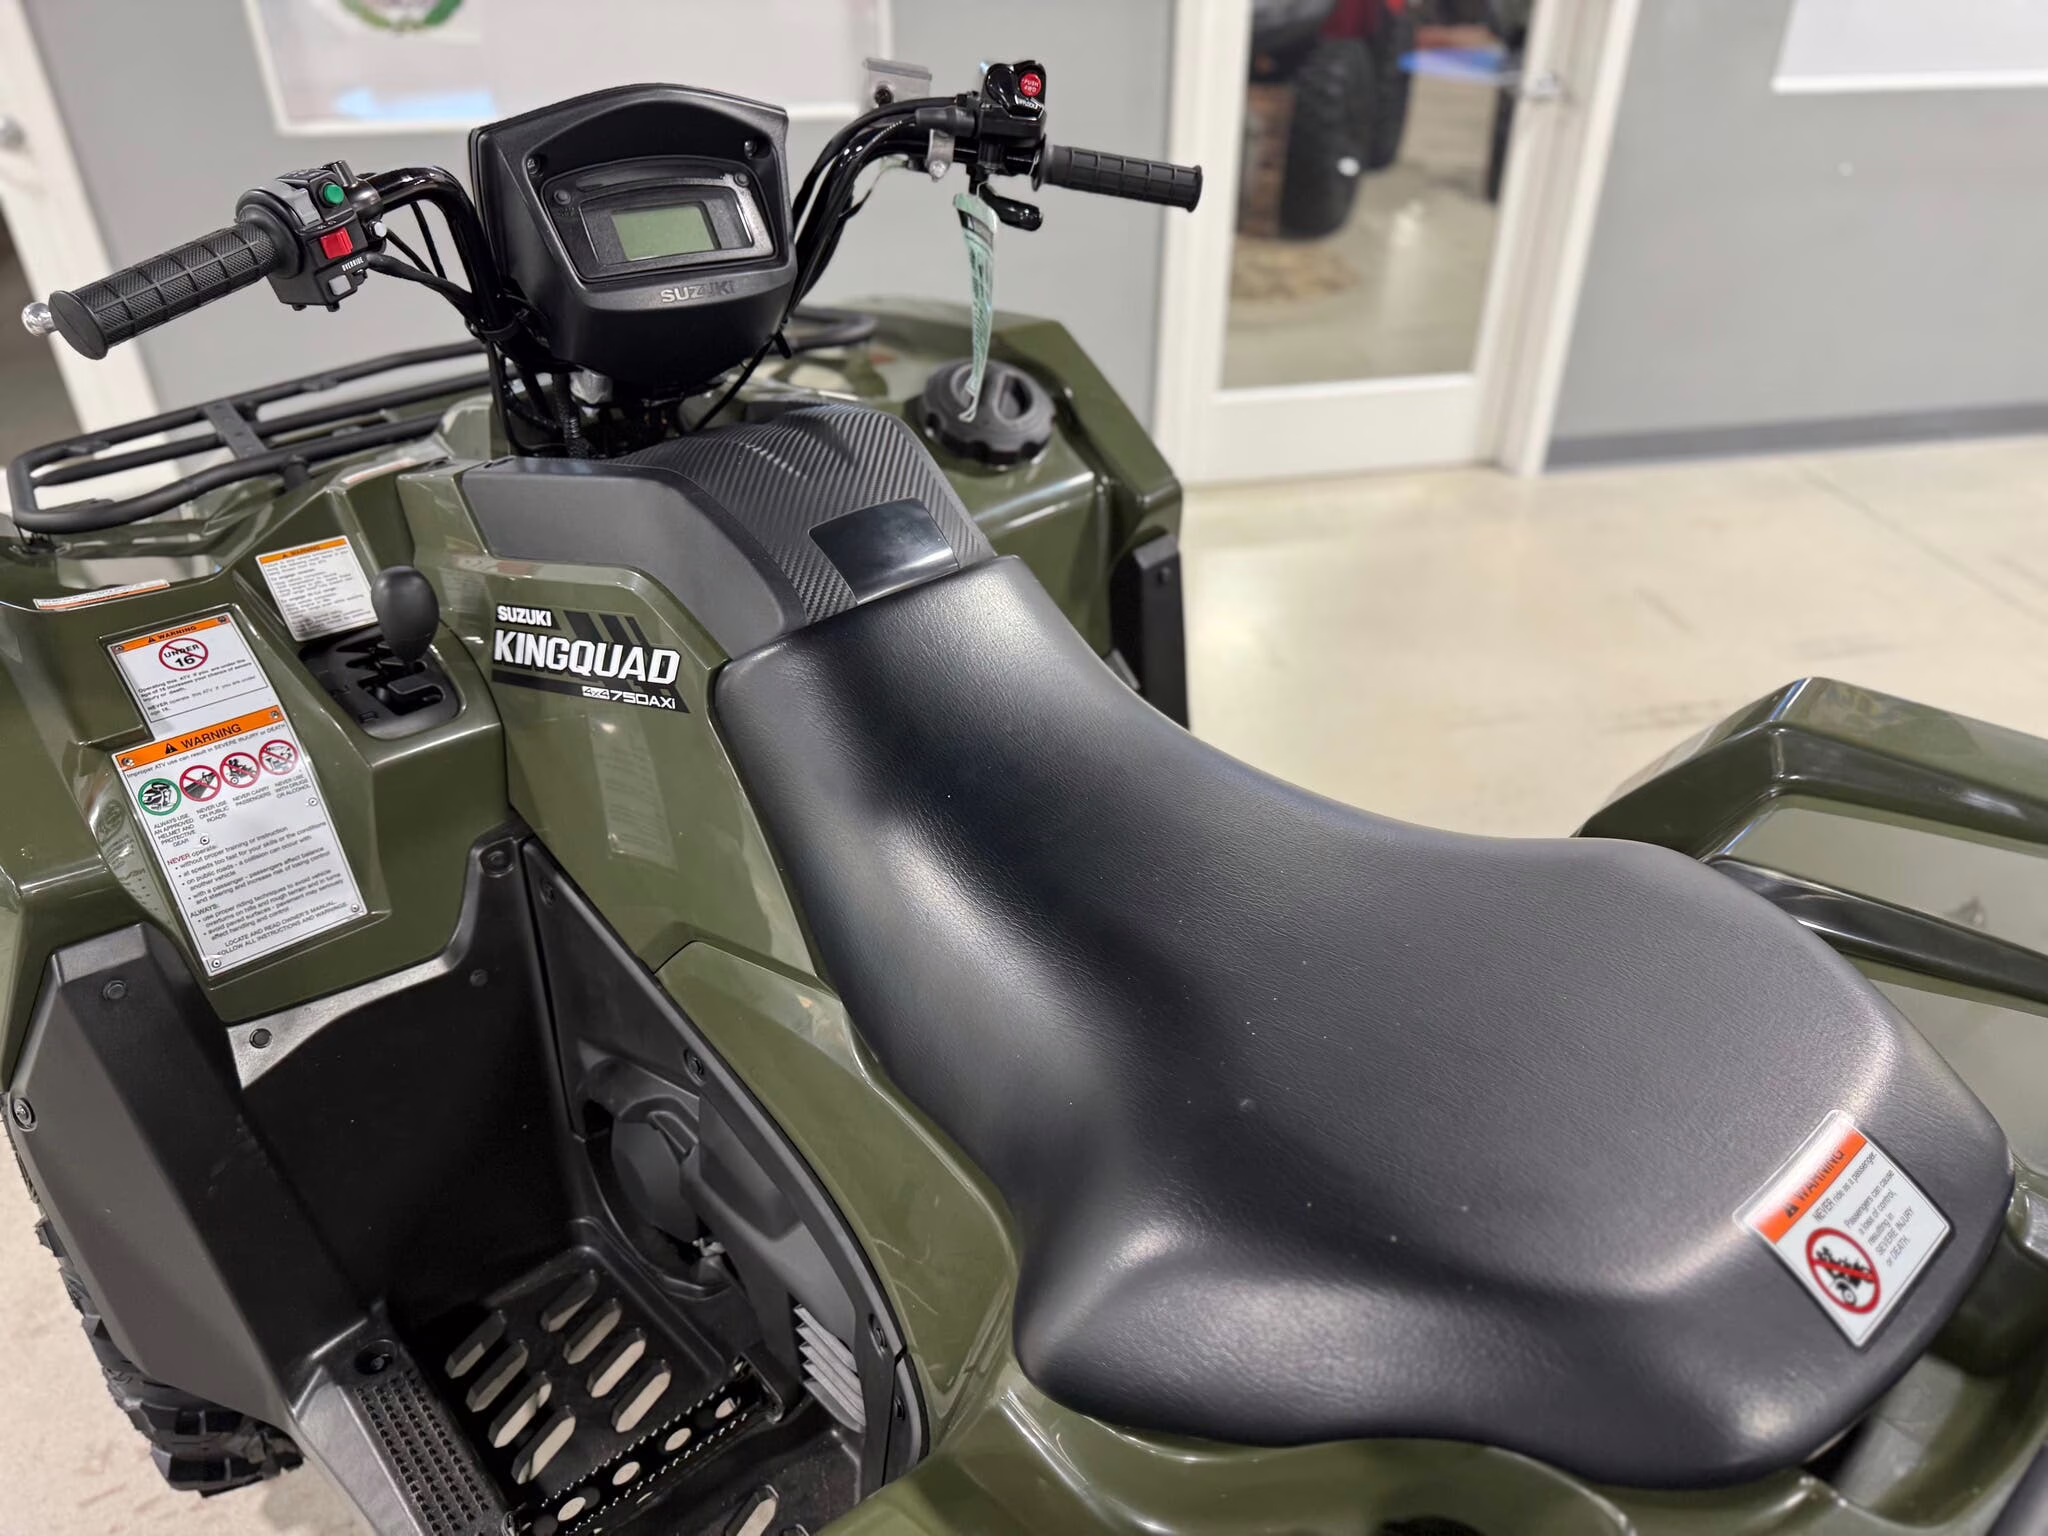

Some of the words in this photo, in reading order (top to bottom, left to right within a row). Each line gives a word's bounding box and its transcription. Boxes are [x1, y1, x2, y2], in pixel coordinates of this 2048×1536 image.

[341, 256, 365, 272] OVERRIDE
[660, 280, 736, 303] SUZUKI
[497, 605, 552, 627] SUZUKI
[158, 625, 197, 639] WARNING
[163, 643, 200, 658] UNDER
[174, 654, 197, 668] 16
[493, 628, 681, 685] KINGQUAD
[180, 723, 242, 749] WARNING
[127, 766, 154, 779] Improper
[190, 749, 207, 757] result
[213, 739, 237, 750] SEVERE
[153, 817, 177, 829] ALWAYS
[177, 813, 190, 821] USE
[195, 804, 216, 814] NEVER
[215, 800, 227, 808] USE
[206, 813, 228, 823] ROADS
[208, 806, 230, 816] PUBLIC
[157, 829, 180, 840] HELMET
[181, 824, 195, 832] AND
[160, 829, 197, 845] PROTECTIVE
[162, 818, 195, 832] APPROVED
[172, 838, 190, 847] GEAR
[179, 857, 203, 869] without
[203, 850, 225, 861] proper
[225, 840, 249, 853] training
[256, 826, 288, 841] instruction
[190, 862, 214, 875] speeds
[225, 853, 238, 861] fast
[248, 845, 262, 854] your
[262, 839, 278, 848] skills
[296, 821, 327, 835] conditions
[167, 853, 191, 866] NEVER
[192, 890, 207, 899] with
[212, 877, 245, 892] passenger
[248, 863, 283, 879] passengers
[283, 855, 301, 865] affect
[301, 846, 325, 858] balance
[195, 870, 216, 882] public
[215, 864, 234, 874] roads
[281, 841, 299, 850] occur
[298, 835, 312, 843] with
[189, 878, 214, 891] another
[195, 896, 208, 905] and
[208, 887, 235, 901] steering
[234, 882, 247, 890] and
[246, 872, 273, 886] increase
[272, 868, 284, 876] risk
[291, 858, 310, 870] losing
[309, 851, 331, 862] control
[202, 914, 214, 922] use
[215, 907, 235, 918] proper
[235, 898, 254, 910] riding
[253, 886, 287, 903] techniques
[294, 877, 311, 886] avoid
[311, 869, 332, 880] vehicle
[205, 913, 235, 928] overturns
[244, 905, 257, 913] hills
[257, 900, 270, 908] and
[269, 893, 288, 904] rough
[287, 885, 307, 896] terrain
[325, 872, 341, 881] turns
[208, 924, 225, 934] avoid
[225, 917, 246, 928] paved
[245, 906, 271, 920] surfaces
[275, 893, 305, 909] pavement
[305, 889, 318, 897] may
[318, 878, 344, 892] seriously
[211, 930, 229, 941] affect
[229, 919, 256, 934] handling
[255, 914, 268, 923] and
[268, 906, 289, 918] control
[224, 934, 249, 947] LOCATE
[249, 928, 264, 937] AND
[263, 921, 282, 932] READ
[281, 910, 310, 925] OWNER'S
[244, 938, 256, 946] ALL
[256, 920, 301, 941] INSTRUCTIONS
[302, 915, 315, 923] AND
[1794, 1147, 1844, 1203] WARNING
[1813, 1198, 1834, 1222] NEVER
[1832, 1188, 1843, 1201] ride
[1841, 1182, 1850, 1191] as
[1852, 1151, 1878, 1181] passenger.
[1844, 1194, 1875, 1230] Passengers
[1872, 1186, 1881, 1197] can
[1880, 1171, 1893, 1187] cause
[1861, 1215, 1873, 1229] loss
[1870, 1208, 1879, 1218] of
[1867, 1219, 1890, 1246] resulting
[1886, 1212, 1894, 1221] in
[1875, 1228, 1898, 1256] SEVERE
[1895, 1207, 1915, 1231] INJURY
[1886, 1258, 1893, 1266] or
[1890, 1235, 1910, 1260] DEATH
